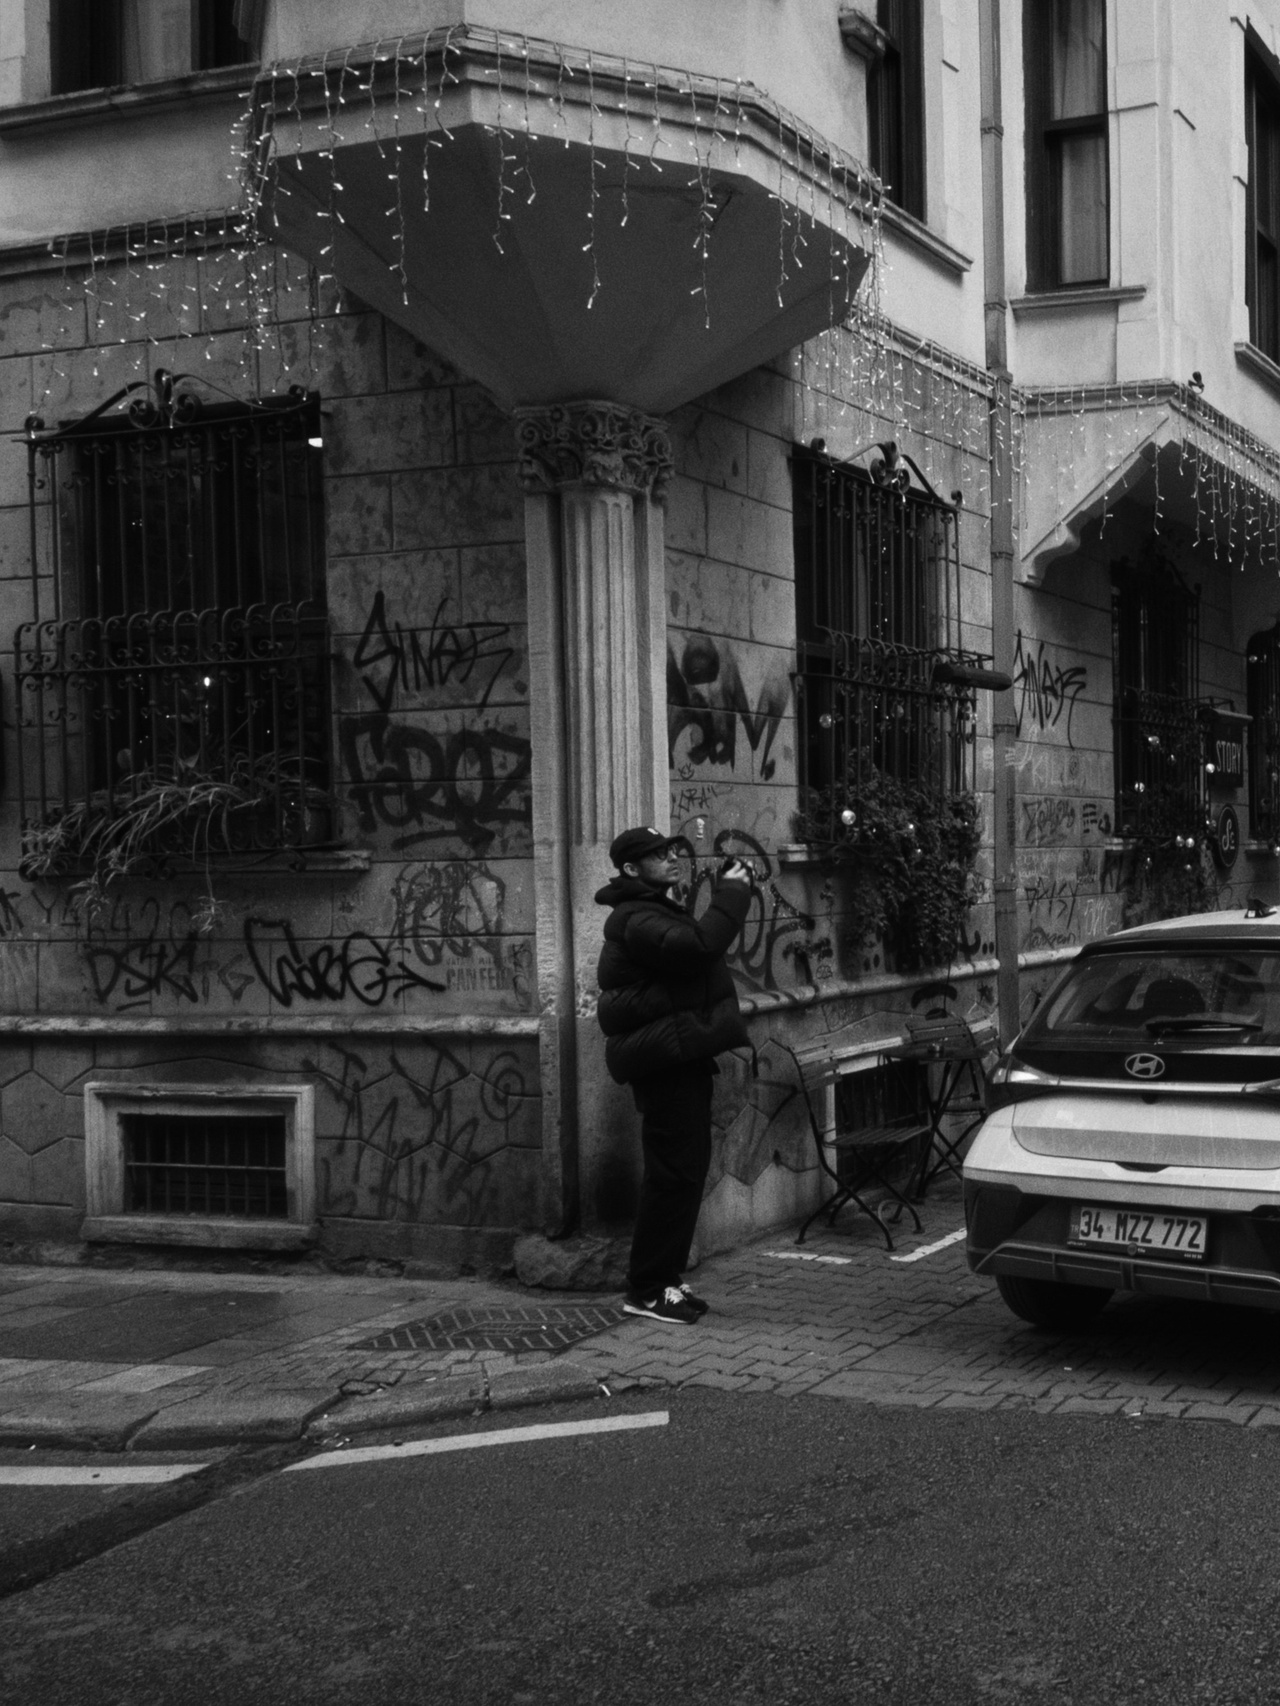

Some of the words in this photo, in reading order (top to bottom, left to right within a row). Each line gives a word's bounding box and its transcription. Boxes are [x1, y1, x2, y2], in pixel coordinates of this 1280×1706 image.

[1216, 740, 1242, 775] STORY
[1080, 1210, 1104, 1239] 34
[1115, 1213, 1154, 1244] MZZ
[1162, 1217, 1202, 1249] 772
